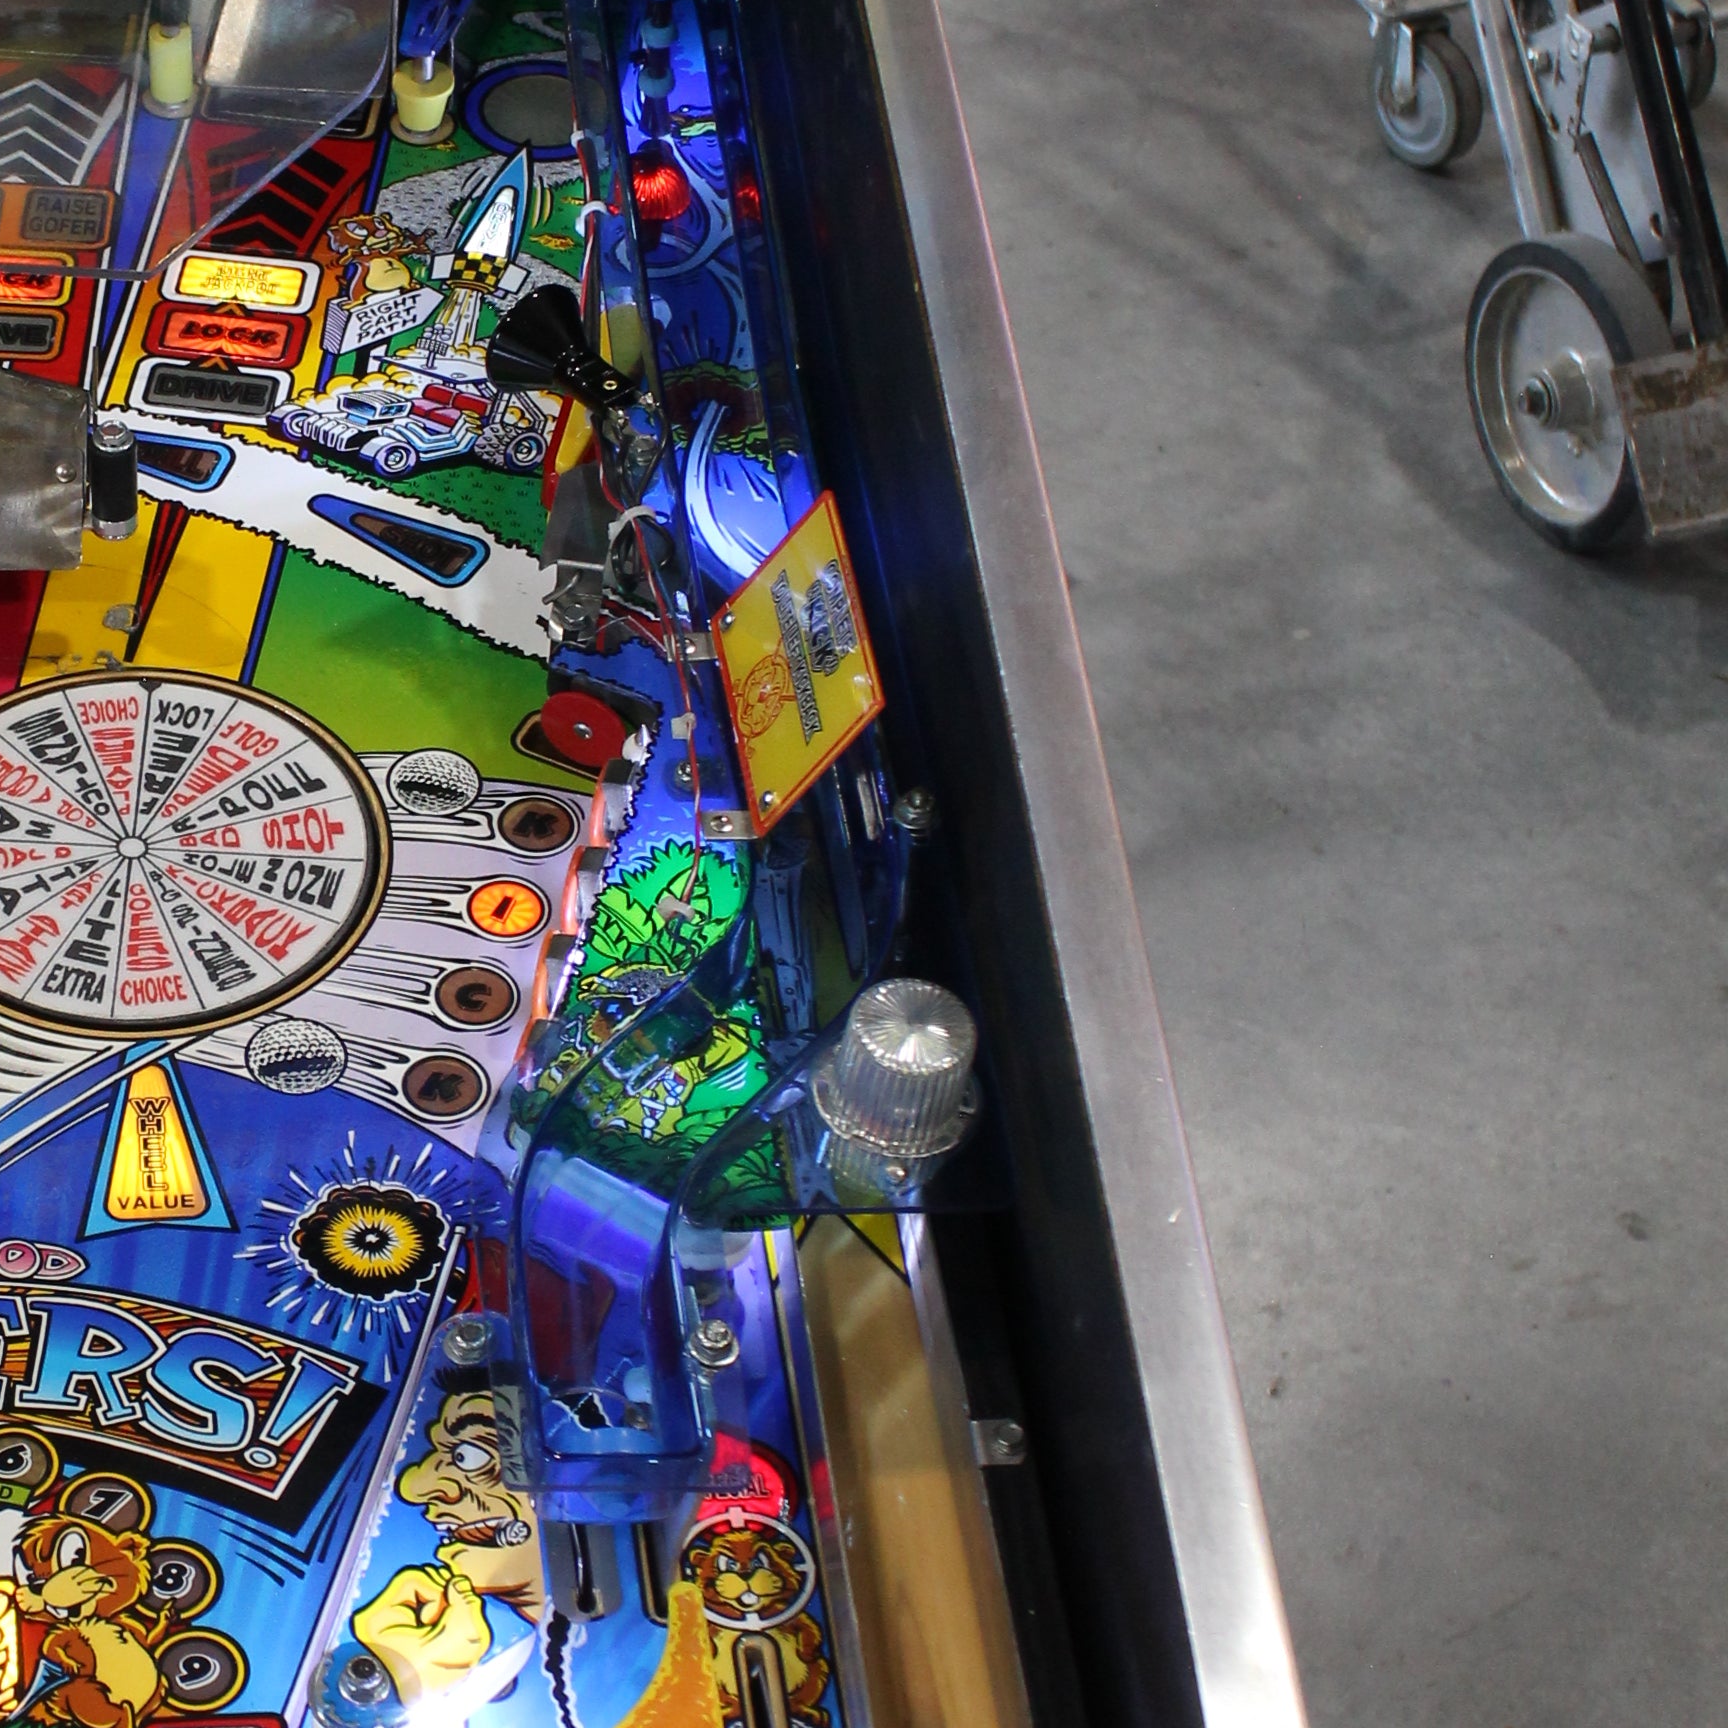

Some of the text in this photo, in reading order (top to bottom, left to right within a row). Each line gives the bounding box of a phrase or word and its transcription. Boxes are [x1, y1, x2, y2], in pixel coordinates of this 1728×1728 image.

[37, 195, 97, 215] RAISE
[27, 216, 97, 236] GOFER
[356, 293, 422, 324] RIGHT
[359, 306, 417, 333] CART
[179, 320, 281, 348] LOCK
[356, 314, 418, 344] PATH
[154, 373, 270, 407] DRIVE
[823, 559, 858, 660] COMPLETE
[77, 696, 139, 725] CHOICE
[154, 699, 214, 731] LOCK
[220, 721, 279, 755] GOLF
[262, 809, 345, 853] SHOT
[126, 883, 174, 973] GOFERS
[166, 865, 316, 962] KICKBACK
[41, 963, 108, 1006] EXTRA
[120, 974, 188, 1006] CHOICE
[130, 1097, 171, 1191] WHEEL
[116, 1193, 196, 1213] VALUE
